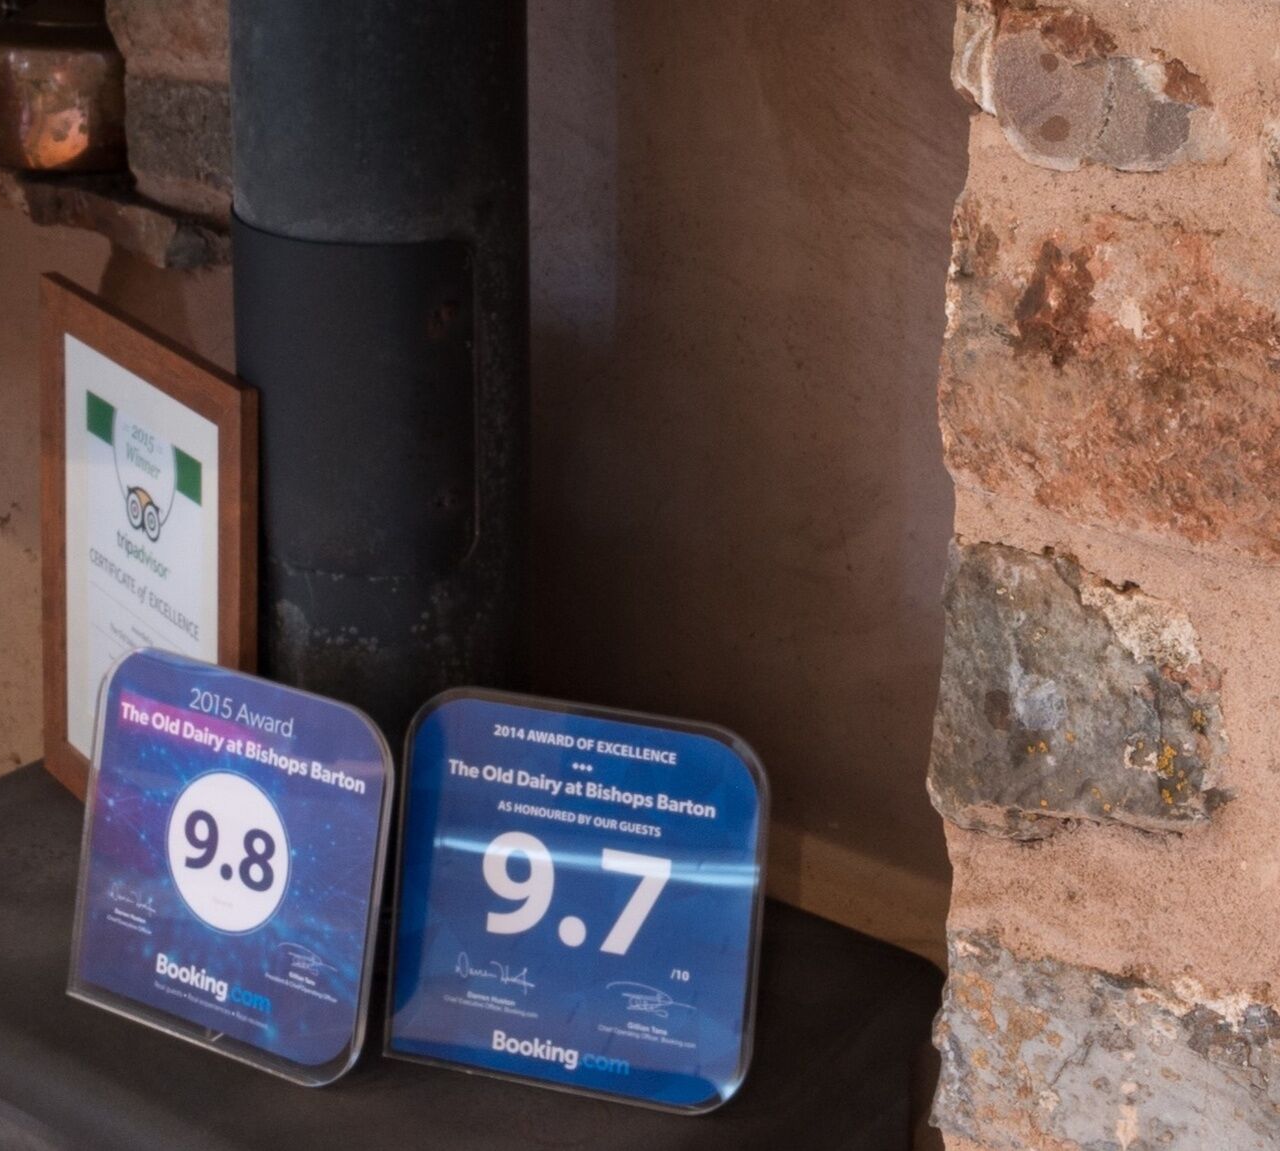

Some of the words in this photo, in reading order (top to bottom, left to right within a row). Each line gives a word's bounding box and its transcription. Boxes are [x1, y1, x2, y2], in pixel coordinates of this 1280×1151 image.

[125, 441, 161, 480] Winner
[131, 424, 155, 454] 2015
[116, 529, 169, 580] tripadvisor
[89, 547, 136, 595] CERTIFICATE
[136, 586, 148, 605] of
[148, 591, 200, 642] EXCELLENCE
[188, 687, 234, 720] 2015
[235, 703, 295, 738] Award
[120, 701, 149, 725] The
[151, 711, 180, 736] Old
[182, 722, 225, 753] Dairy
[226, 737, 243, 756] at
[245, 740, 308, 778] Bishops
[310, 760, 366, 795] Barton
[493, 724, 525, 739] 2014
[527, 729, 574, 748] AWARD
[576, 737, 595, 751] OF
[596, 741, 677, 765] EXCELLENCE
[448, 758, 479, 779] The
[482, 764, 514, 785] Old
[516, 770, 562, 796] Dairy
[564, 780, 583, 797] at
[585, 782, 653, 809] Bishops
[656, 793, 716, 819] Barton
[497, 800, 513, 813] AS
[513, 802, 576, 824] HONOURED
[578, 813, 592, 826] BY
[593, 816, 618, 830] OUR
[619, 821, 662, 838] GUESTS
[183, 809, 277, 893] 9.8
[481, 830, 673, 956] 9.7
[155, 952, 272, 1013] Booking.com
[670, 968, 690, 982] /10
[492, 1029, 631, 1076] Booking.com
